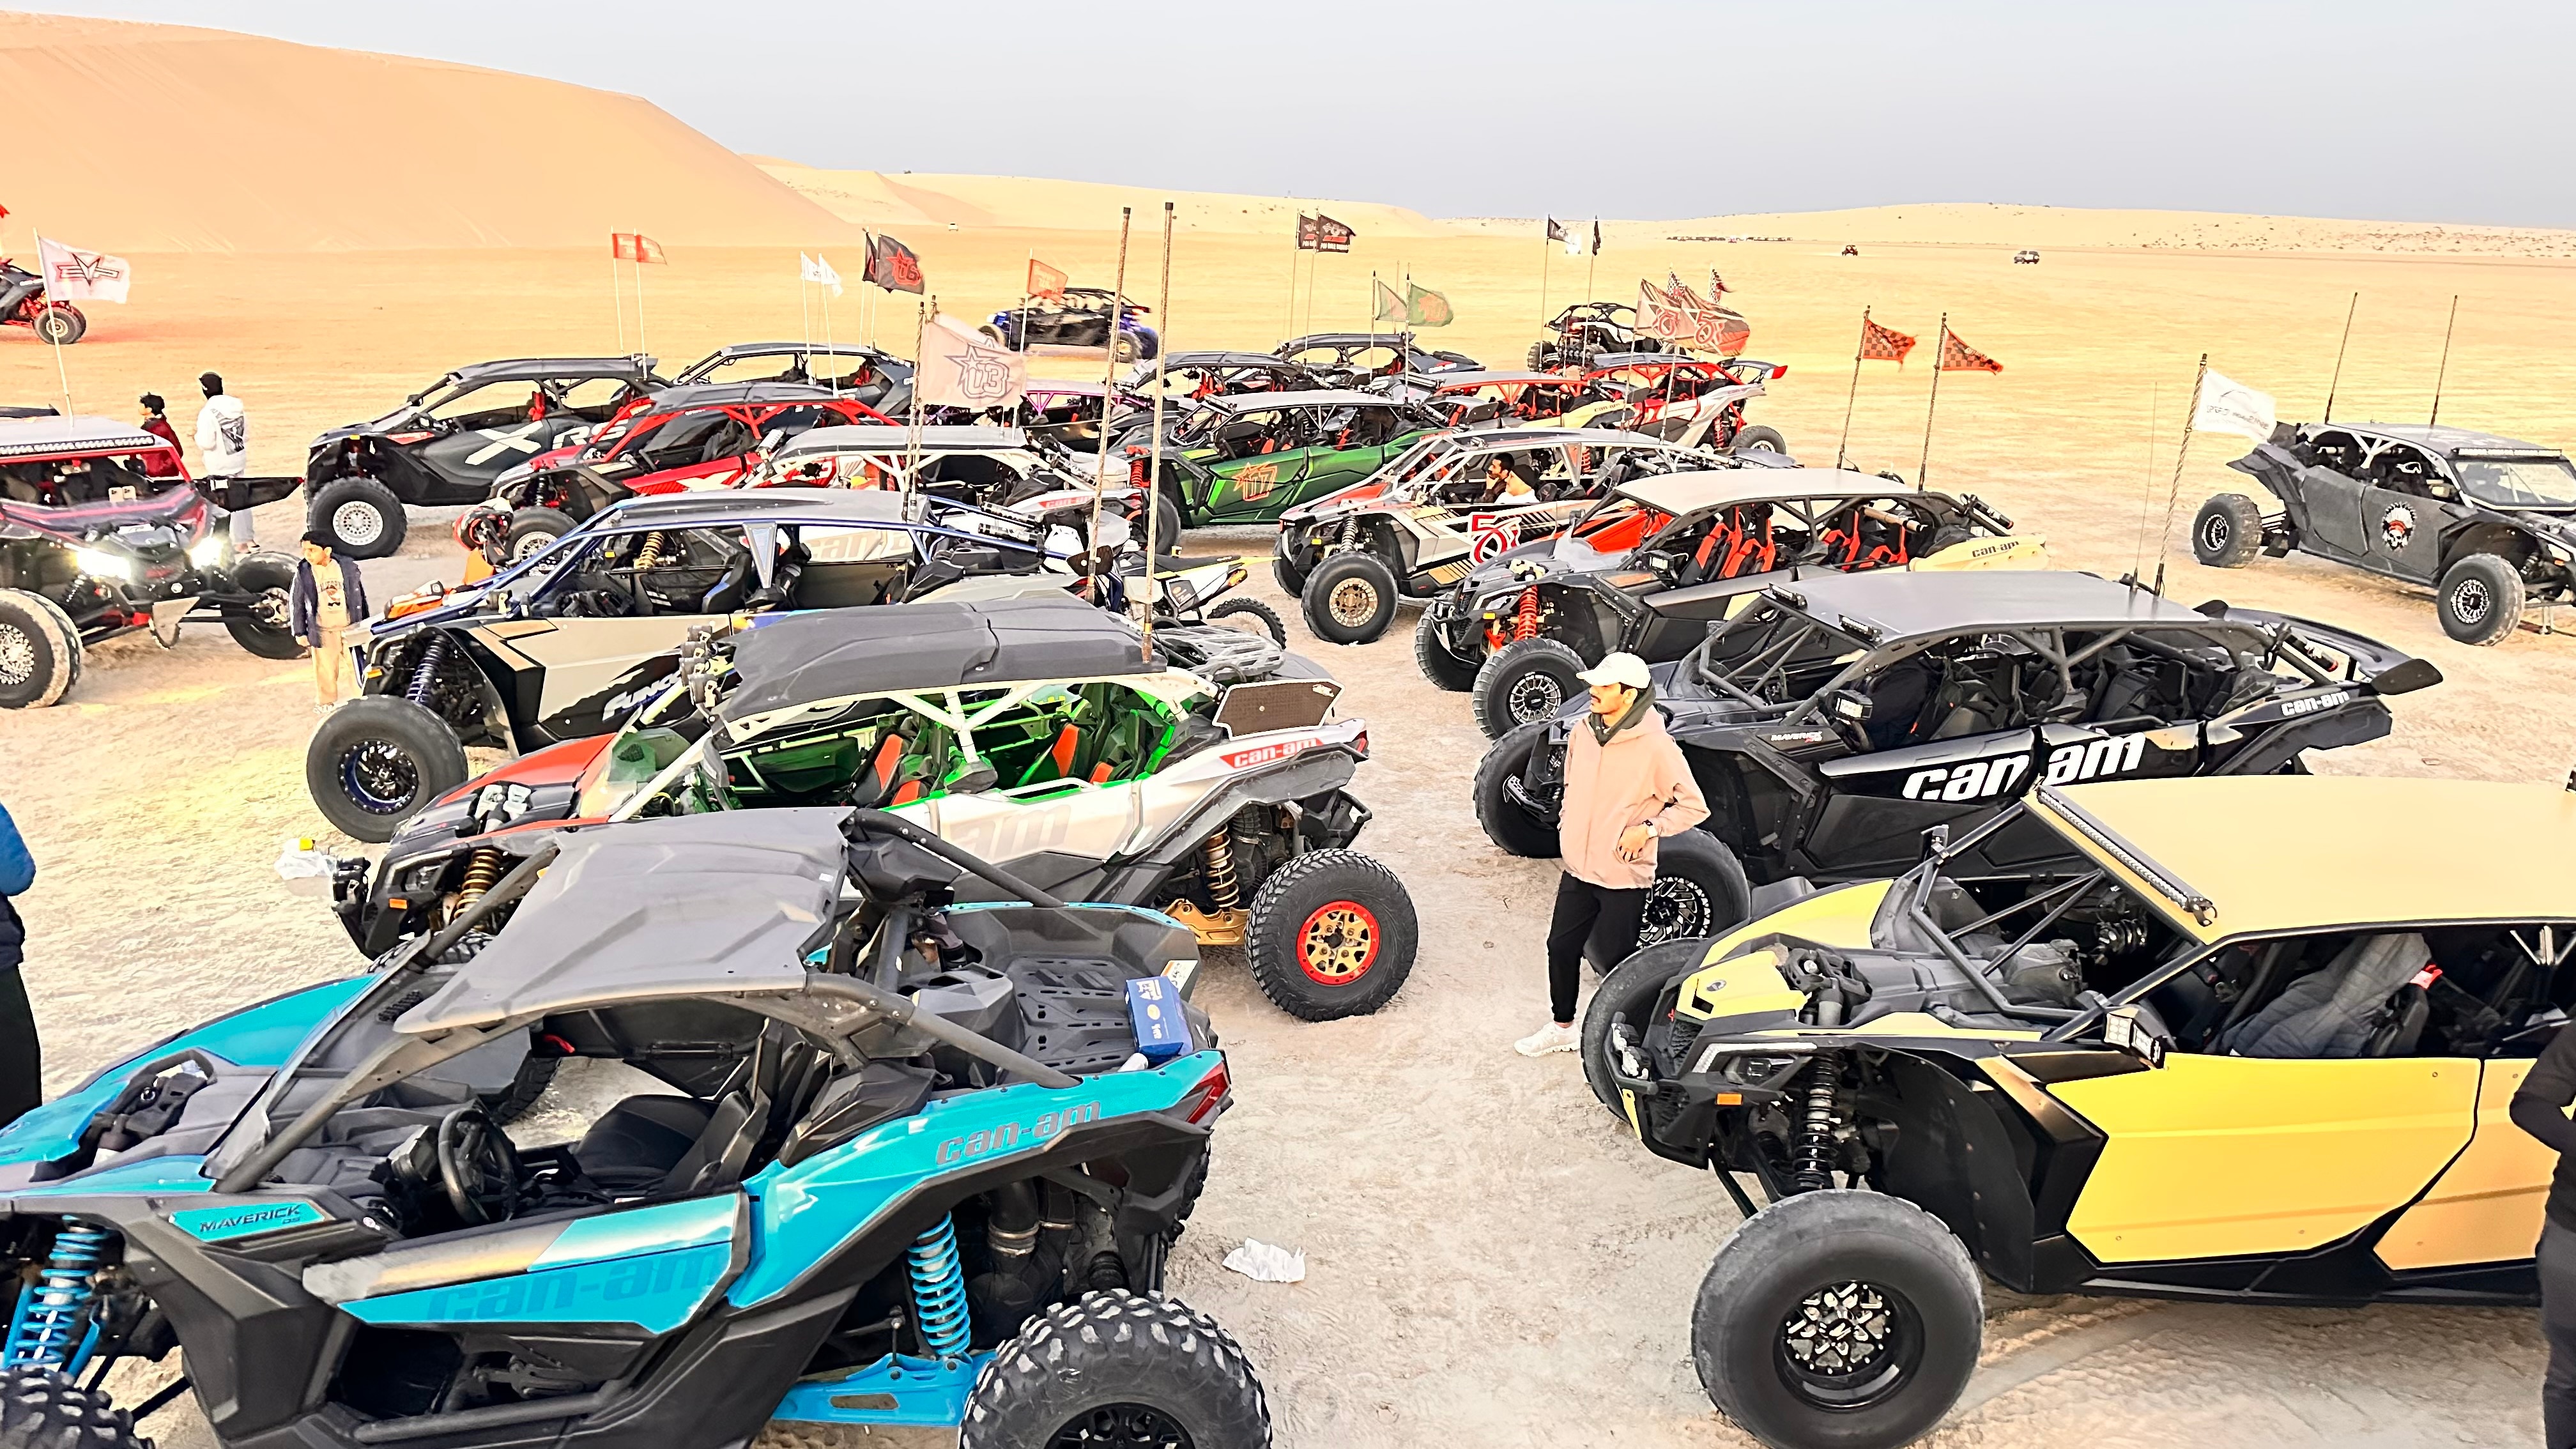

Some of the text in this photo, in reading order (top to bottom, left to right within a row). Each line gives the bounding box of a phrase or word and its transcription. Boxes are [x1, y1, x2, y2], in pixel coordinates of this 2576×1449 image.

[2281, 691, 2350, 716] can-am
[1234, 737, 1317, 767] can-am
[936, 1100, 1101, 1165] can-am
[199, 1204, 302, 1233] MAVERICK
[427, 1250, 722, 1321] can-am
